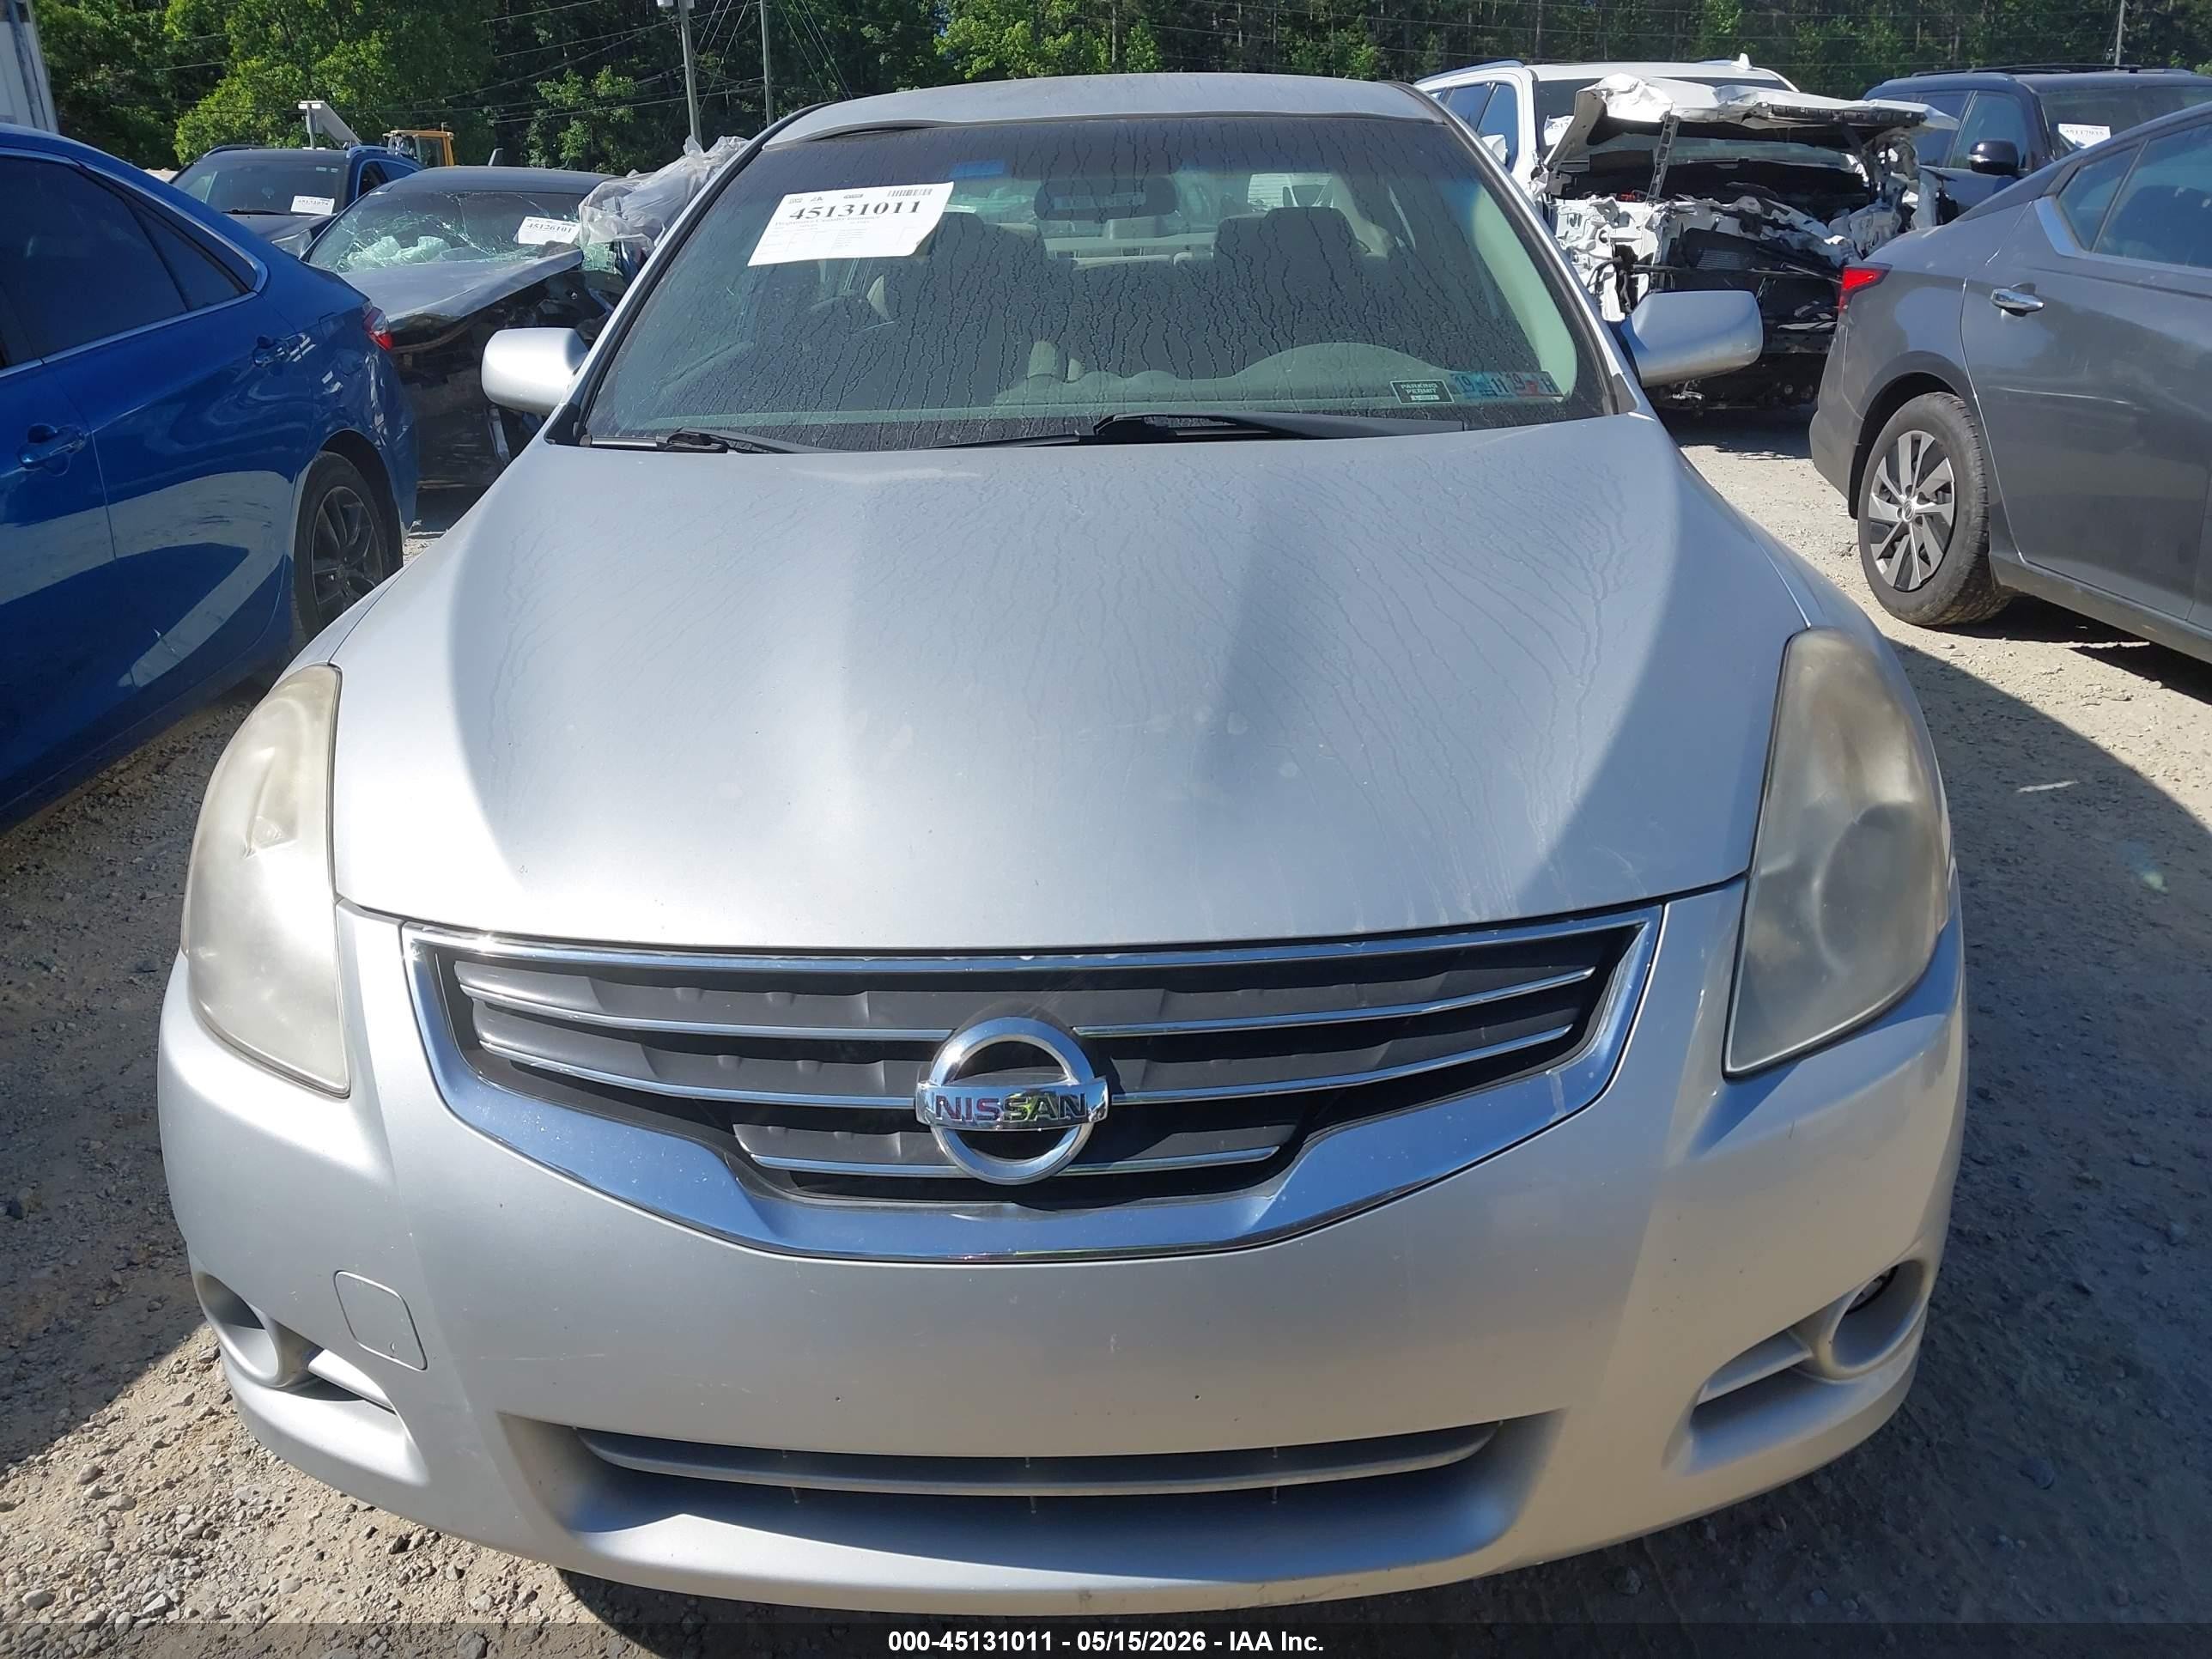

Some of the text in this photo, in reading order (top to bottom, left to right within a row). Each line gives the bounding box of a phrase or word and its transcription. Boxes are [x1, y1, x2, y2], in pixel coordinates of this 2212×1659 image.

[789, 200, 921, 221] 45131011
[526, 222, 572, 234] 45126101
[1455, 375, 1510, 393] 19 11
[934, 1092, 1087, 1122] NISSAN
